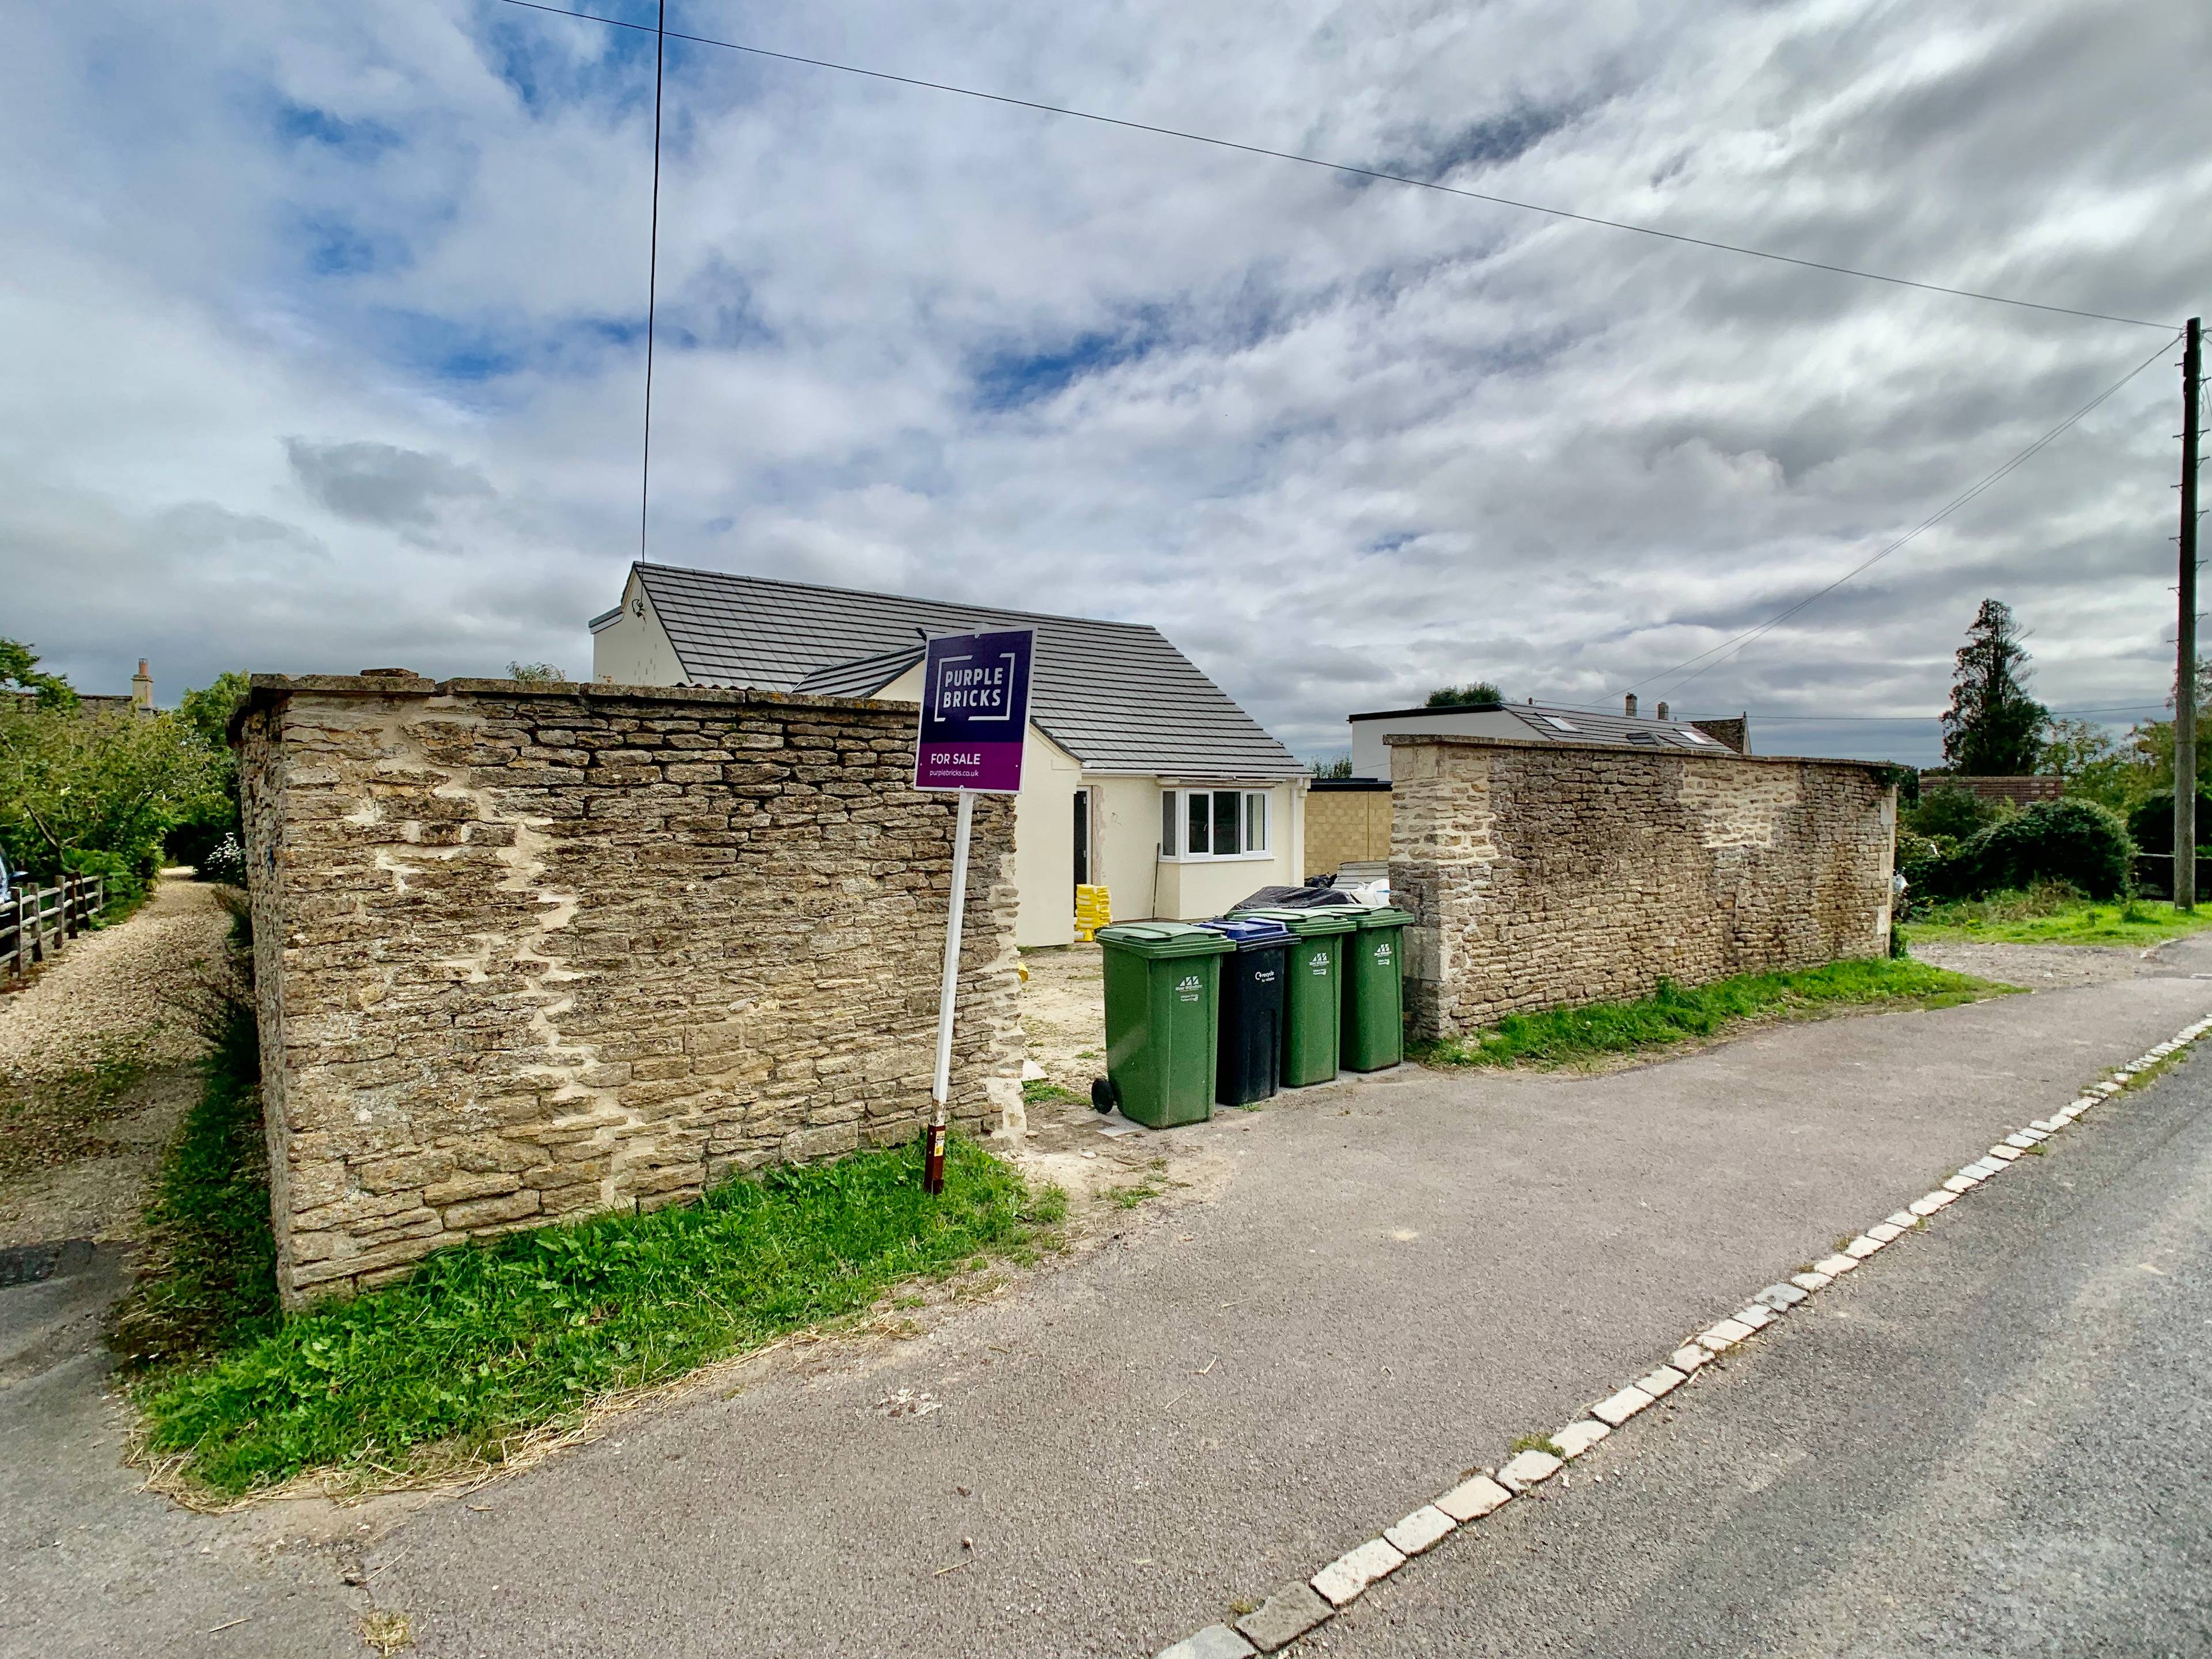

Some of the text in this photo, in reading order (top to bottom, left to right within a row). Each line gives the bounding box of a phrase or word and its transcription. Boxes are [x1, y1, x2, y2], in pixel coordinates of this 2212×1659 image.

[945, 668, 1003, 687] PURPLE
[943, 689, 1001, 708] BRICKS
[930, 753, 980, 765] FOR SALE
[929, 769, 979, 777] purplebricks.co.uk
